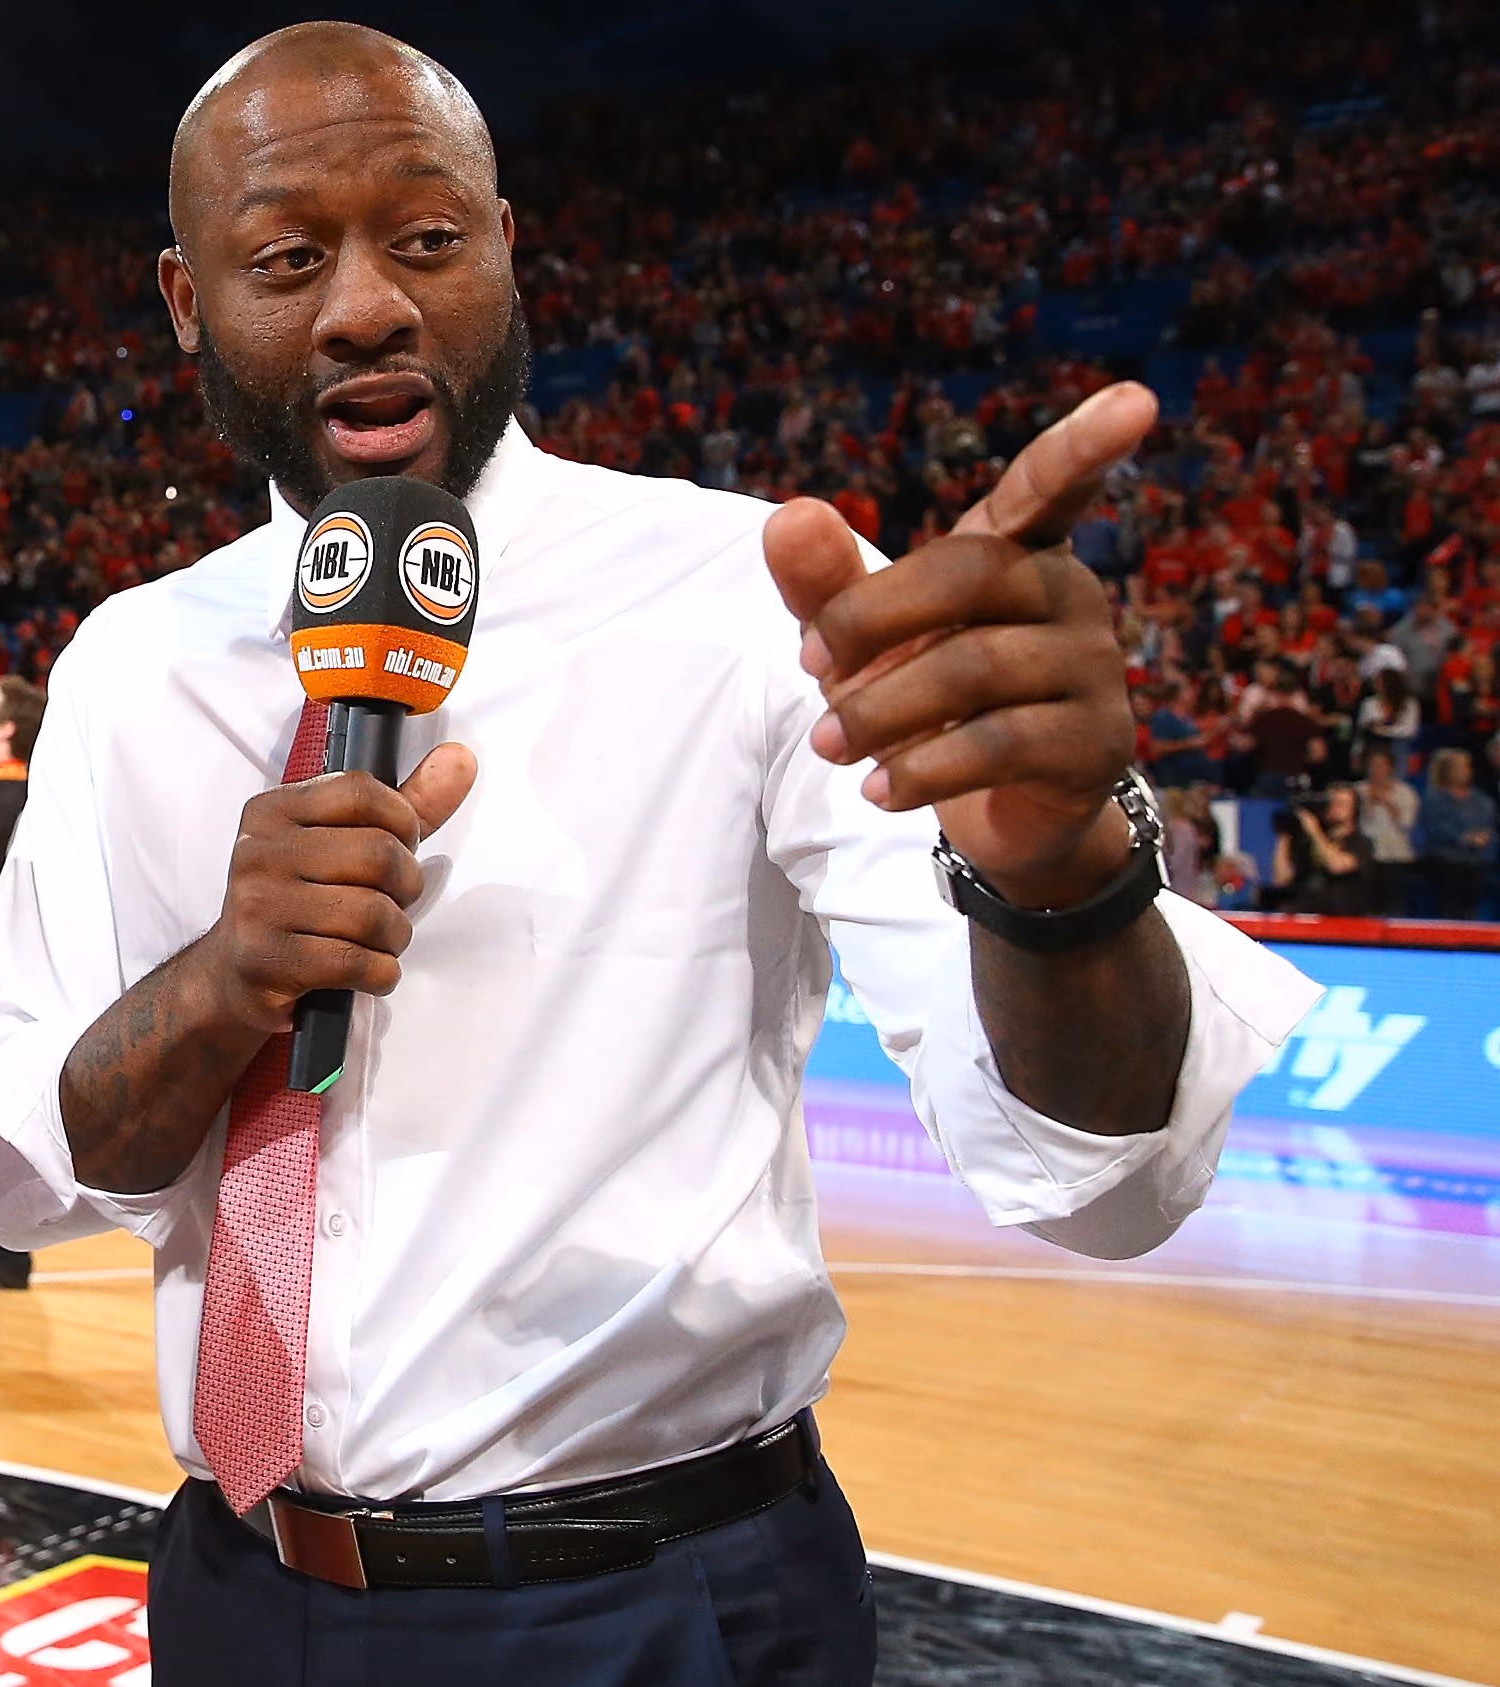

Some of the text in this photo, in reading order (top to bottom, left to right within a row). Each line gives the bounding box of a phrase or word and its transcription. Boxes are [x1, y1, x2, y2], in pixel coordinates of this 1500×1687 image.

[310, 541, 349, 582] NBL
[421, 548, 461, 596] NBL
[383, 648, 456, 688] nbl.com.au
